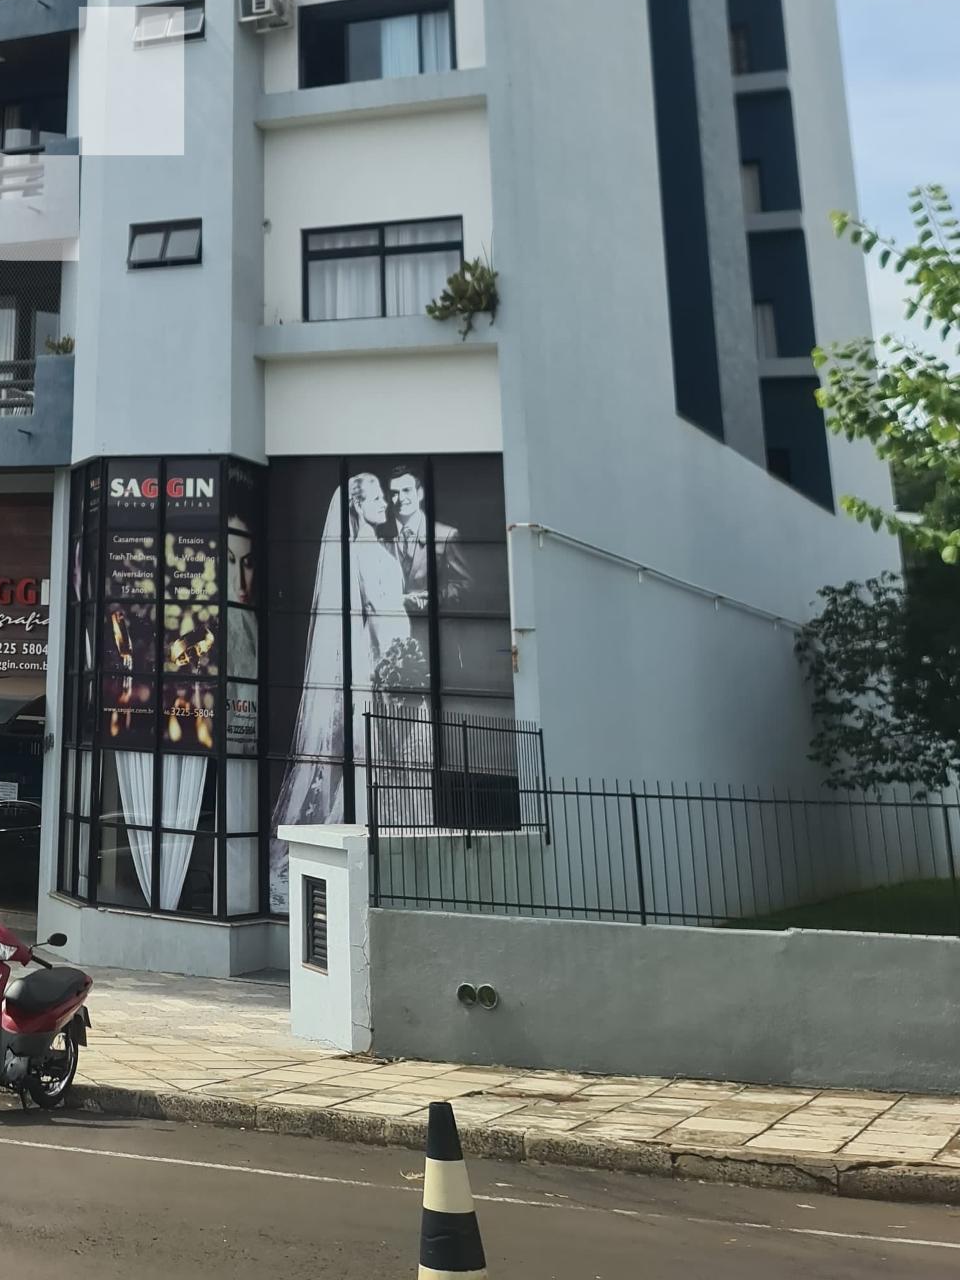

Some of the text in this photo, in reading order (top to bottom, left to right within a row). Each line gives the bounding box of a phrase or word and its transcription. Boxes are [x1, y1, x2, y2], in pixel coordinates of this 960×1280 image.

[110, 477, 214, 498] SAGGIN
[121, 585, 130, 594] 15
[22, 643, 48, 655] 5804
[171, 707, 215, 718] 3225-5804
